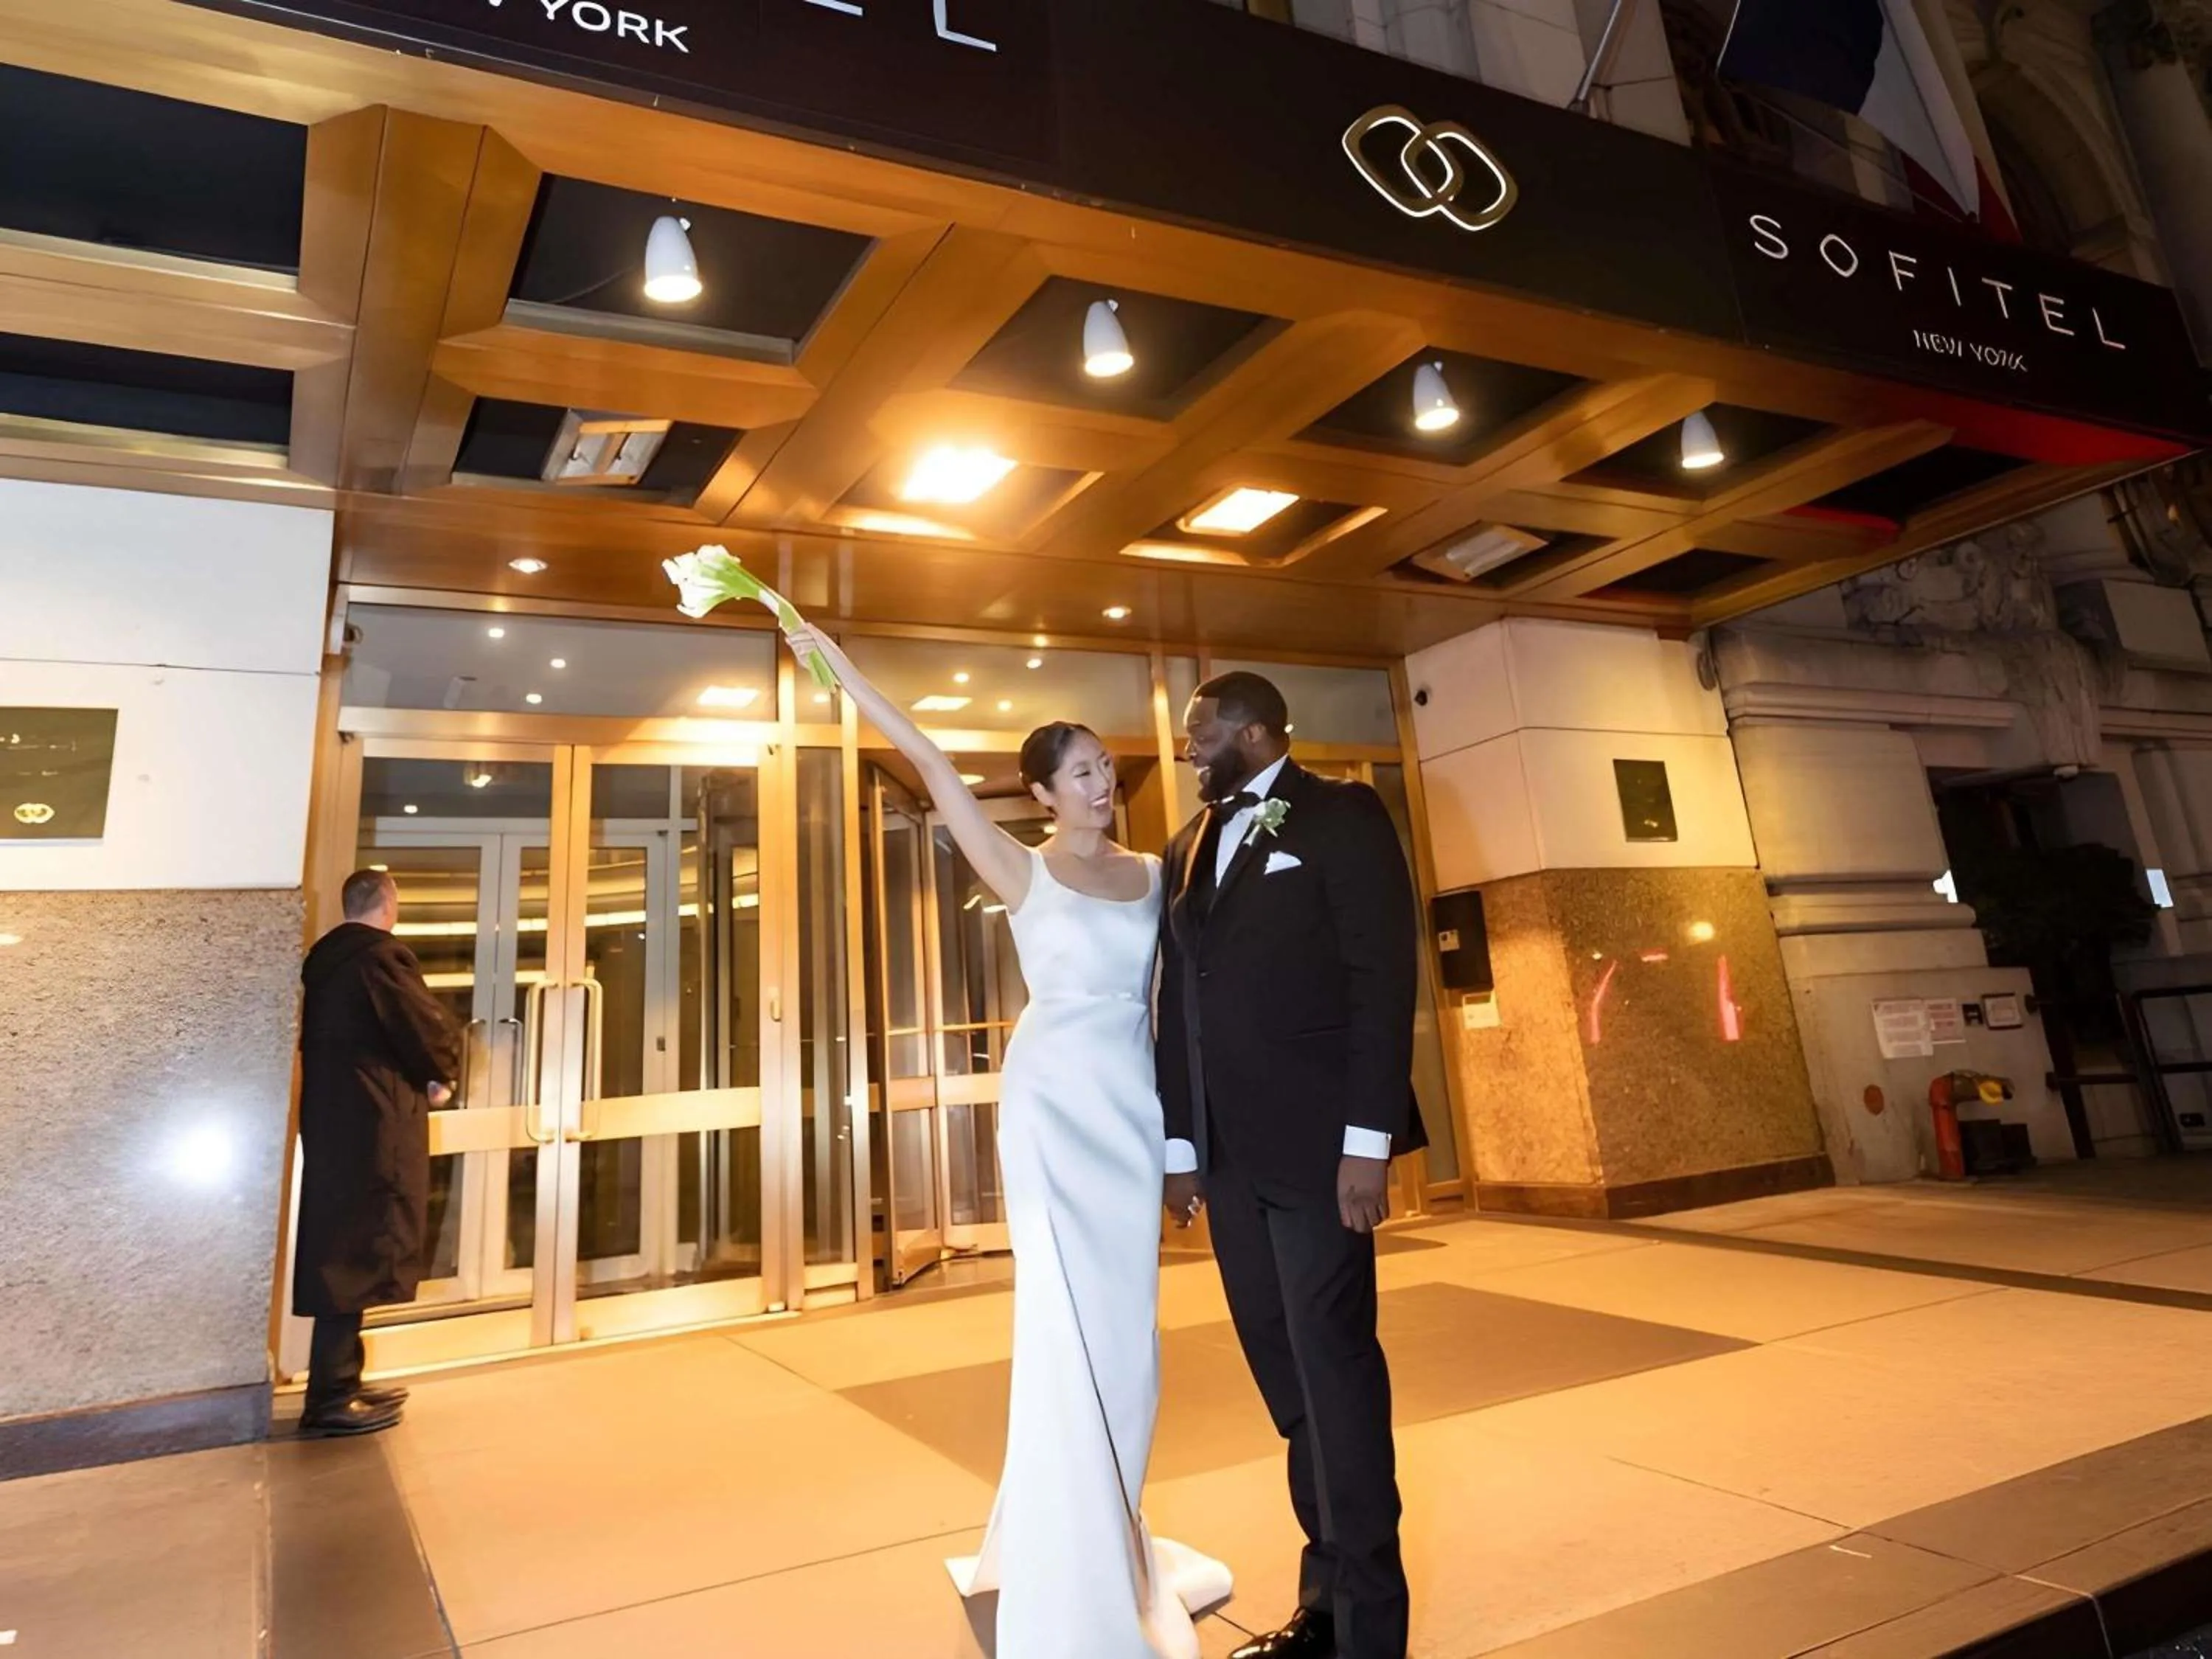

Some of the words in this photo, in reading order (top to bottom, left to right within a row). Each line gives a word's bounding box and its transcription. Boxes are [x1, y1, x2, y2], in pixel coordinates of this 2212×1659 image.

[540, 0, 690, 53] YORK
[1750, 215, 2126, 349] SOFITEL
[1969, 342, 2028, 372] YORK
